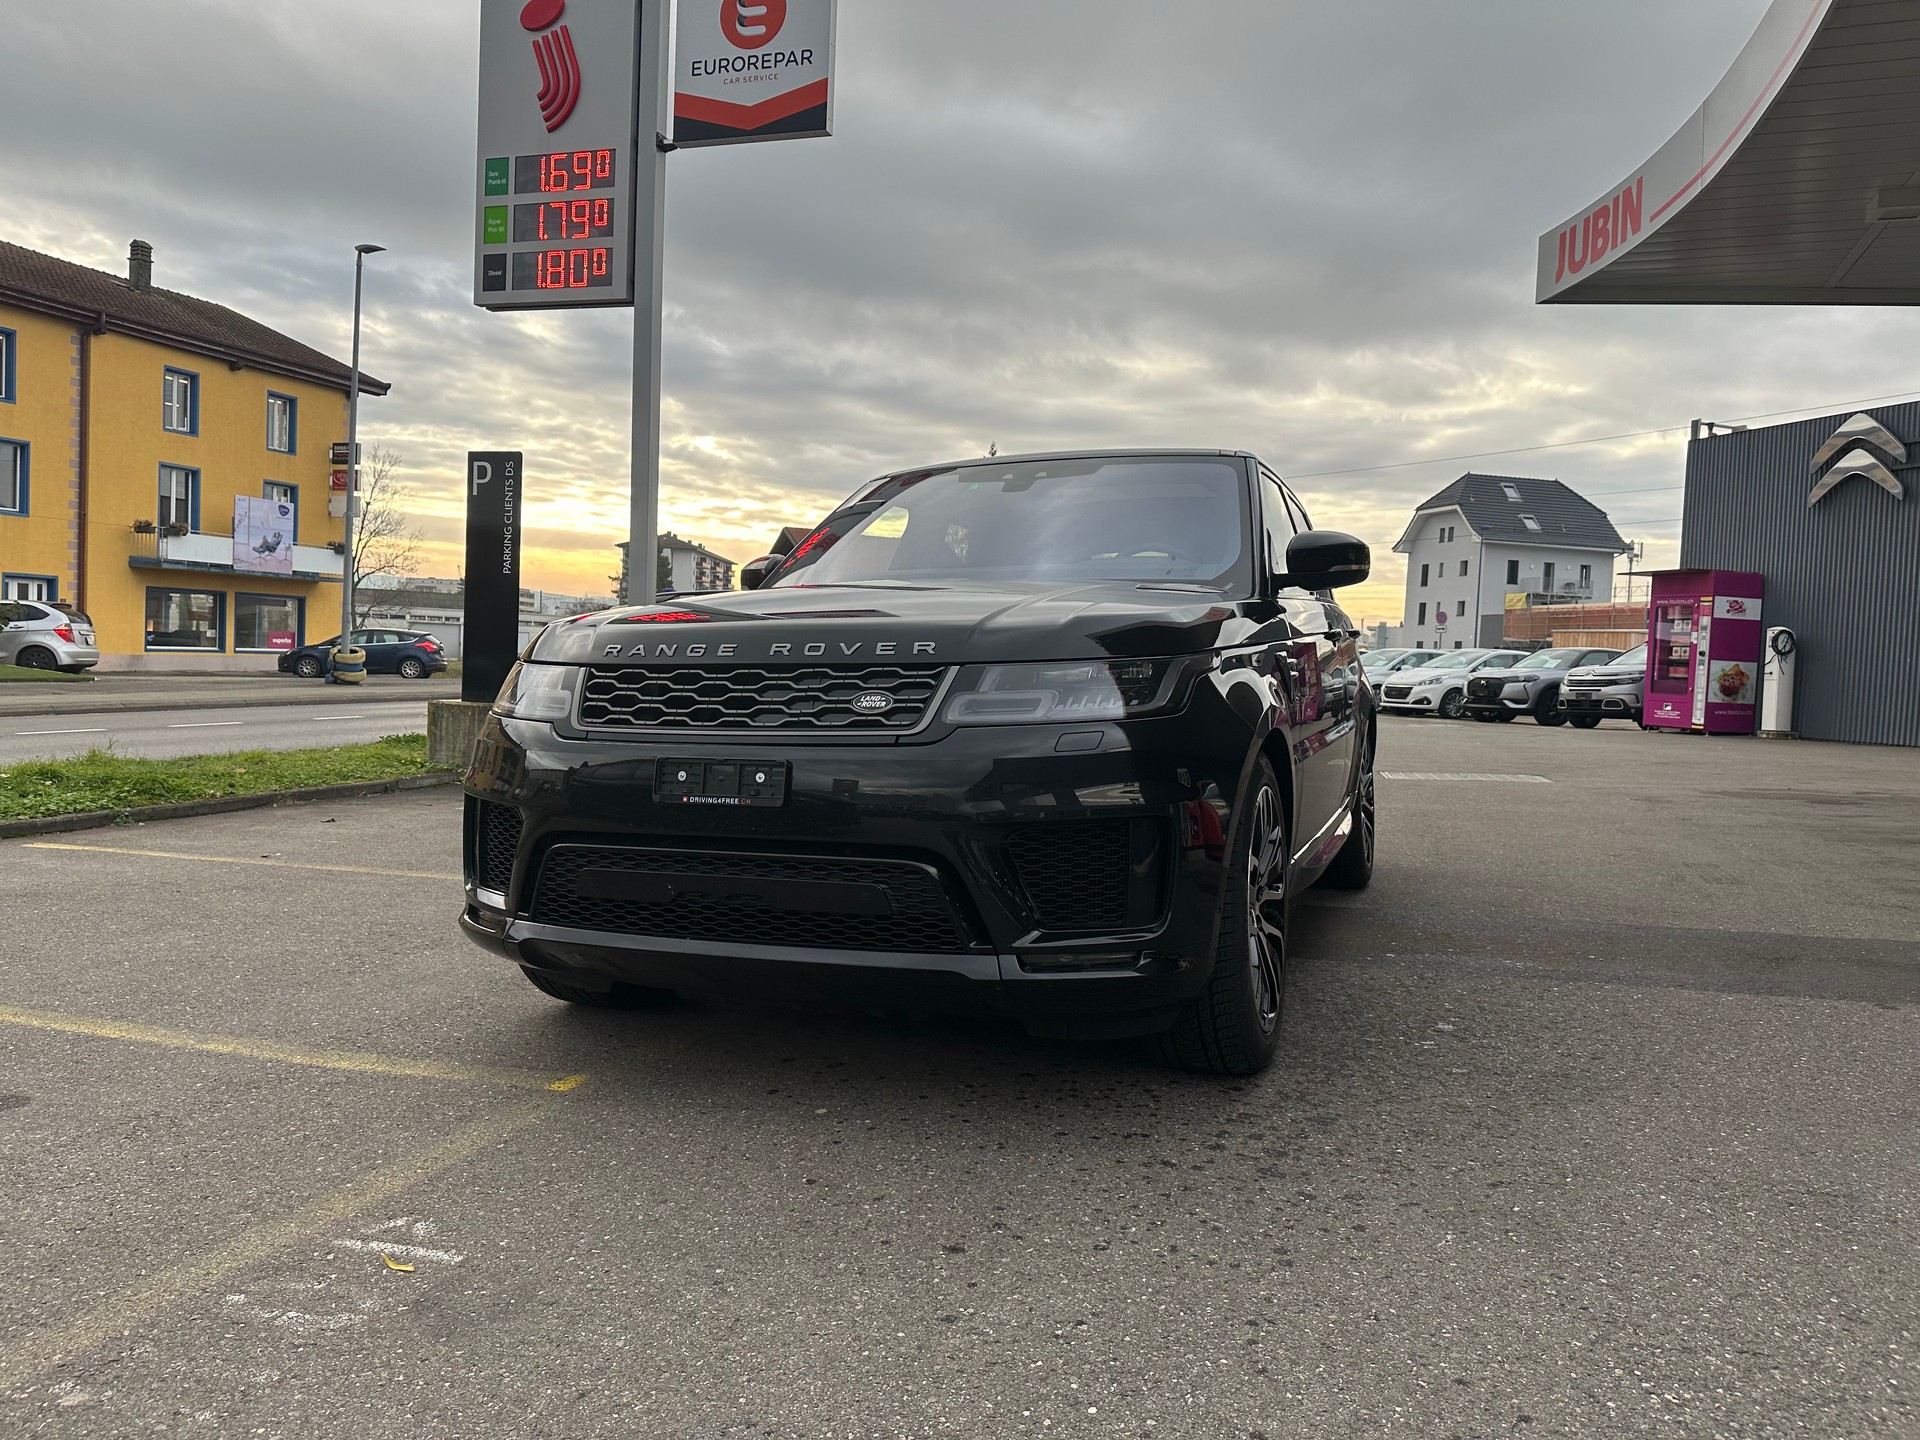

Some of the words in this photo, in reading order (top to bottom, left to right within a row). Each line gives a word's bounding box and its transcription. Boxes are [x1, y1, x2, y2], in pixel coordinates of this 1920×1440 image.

[691, 49, 814, 77] EUROREPAR
[723, 76, 740, 85] CAR
[742, 73, 779, 83] SERVICE
[1555, 175, 1643, 285] JUBIN
[472, 461, 492, 496] P
[505, 460, 514, 476] DS
[504, 478, 514, 524] CLIENTS
[503, 526, 513, 574] PARKING
[602, 643, 739, 658] RANGE
[770, 641, 937, 657] ROVER
